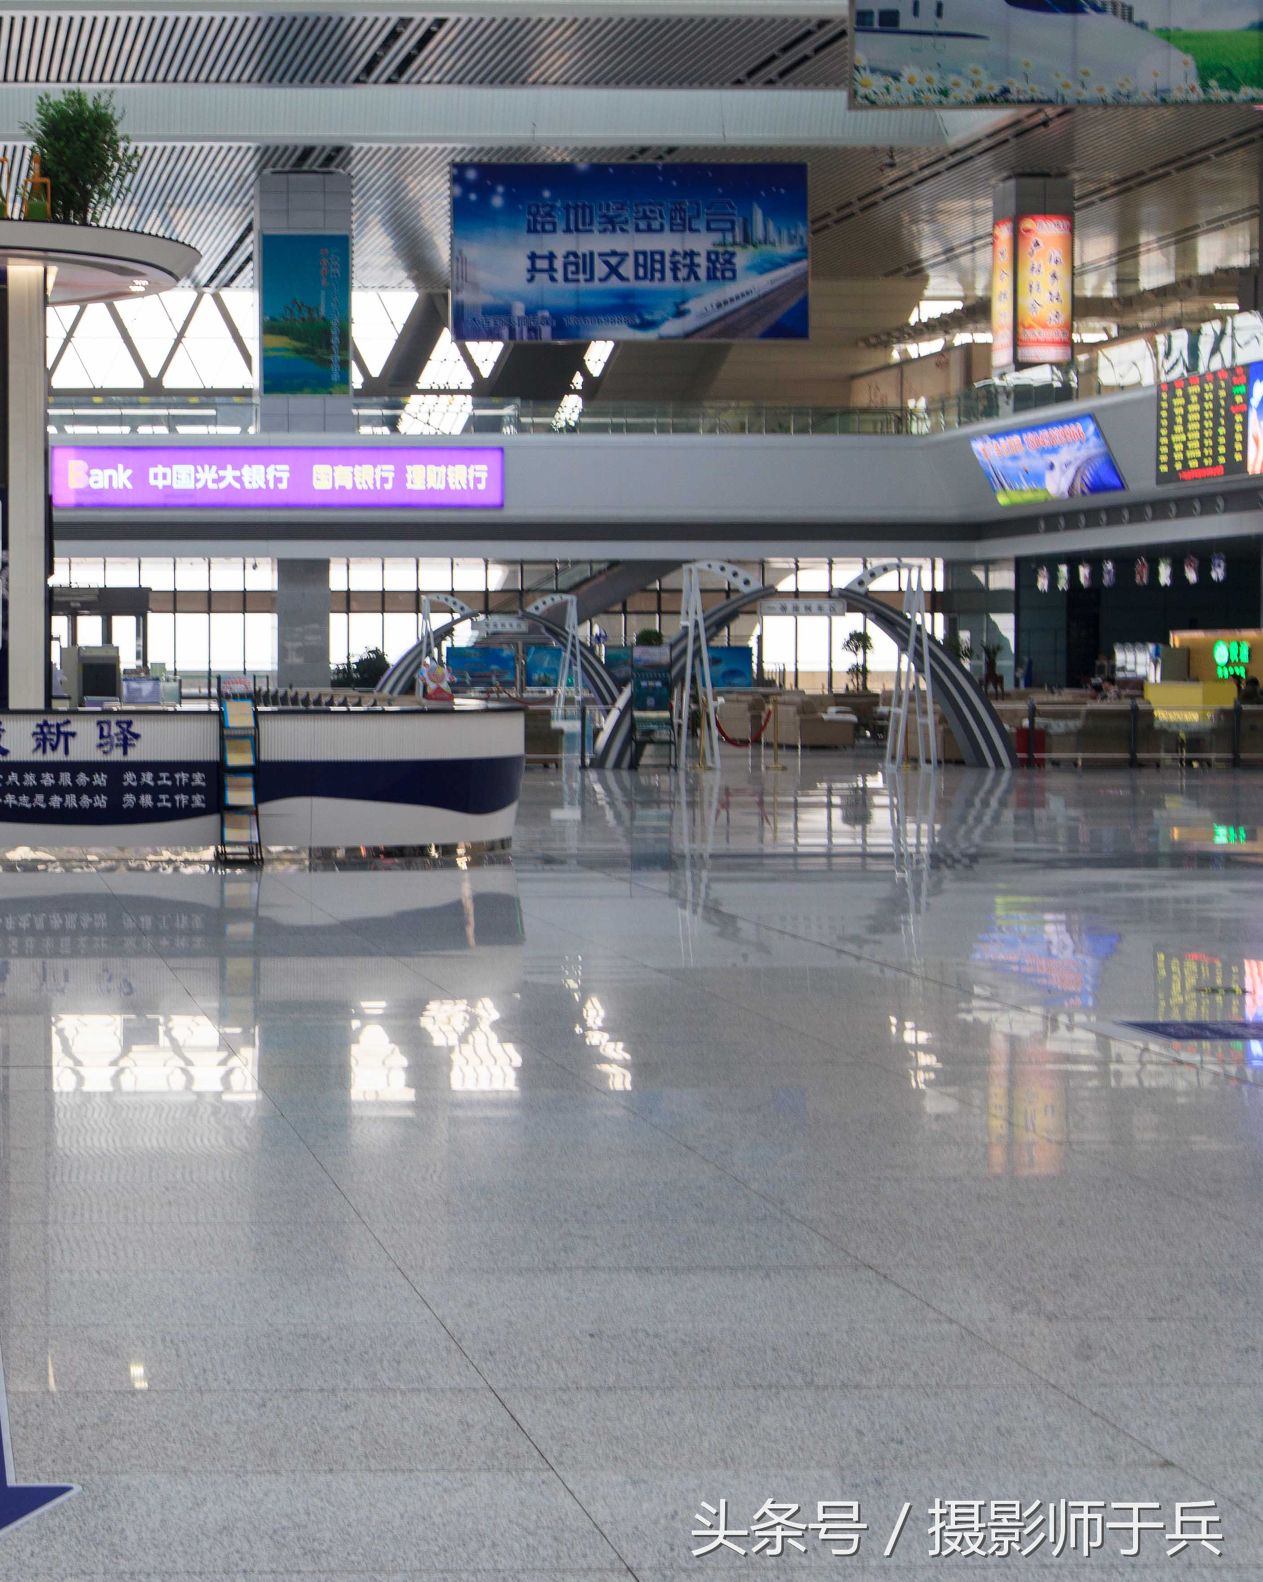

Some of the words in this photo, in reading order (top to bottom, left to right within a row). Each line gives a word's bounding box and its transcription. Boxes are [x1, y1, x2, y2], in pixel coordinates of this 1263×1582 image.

[526, 199, 736, 236] 路地紧密配合
[526, 249, 737, 283] 共创文明铁路
[67, 460, 133, 490] Bank
[148, 464, 291, 490] 中国光大银行
[406, 464, 488, 490] 理财银行
[122, 771, 206, 787] 党建工作室
[122, 793, 206, 809] 劳模工作室
